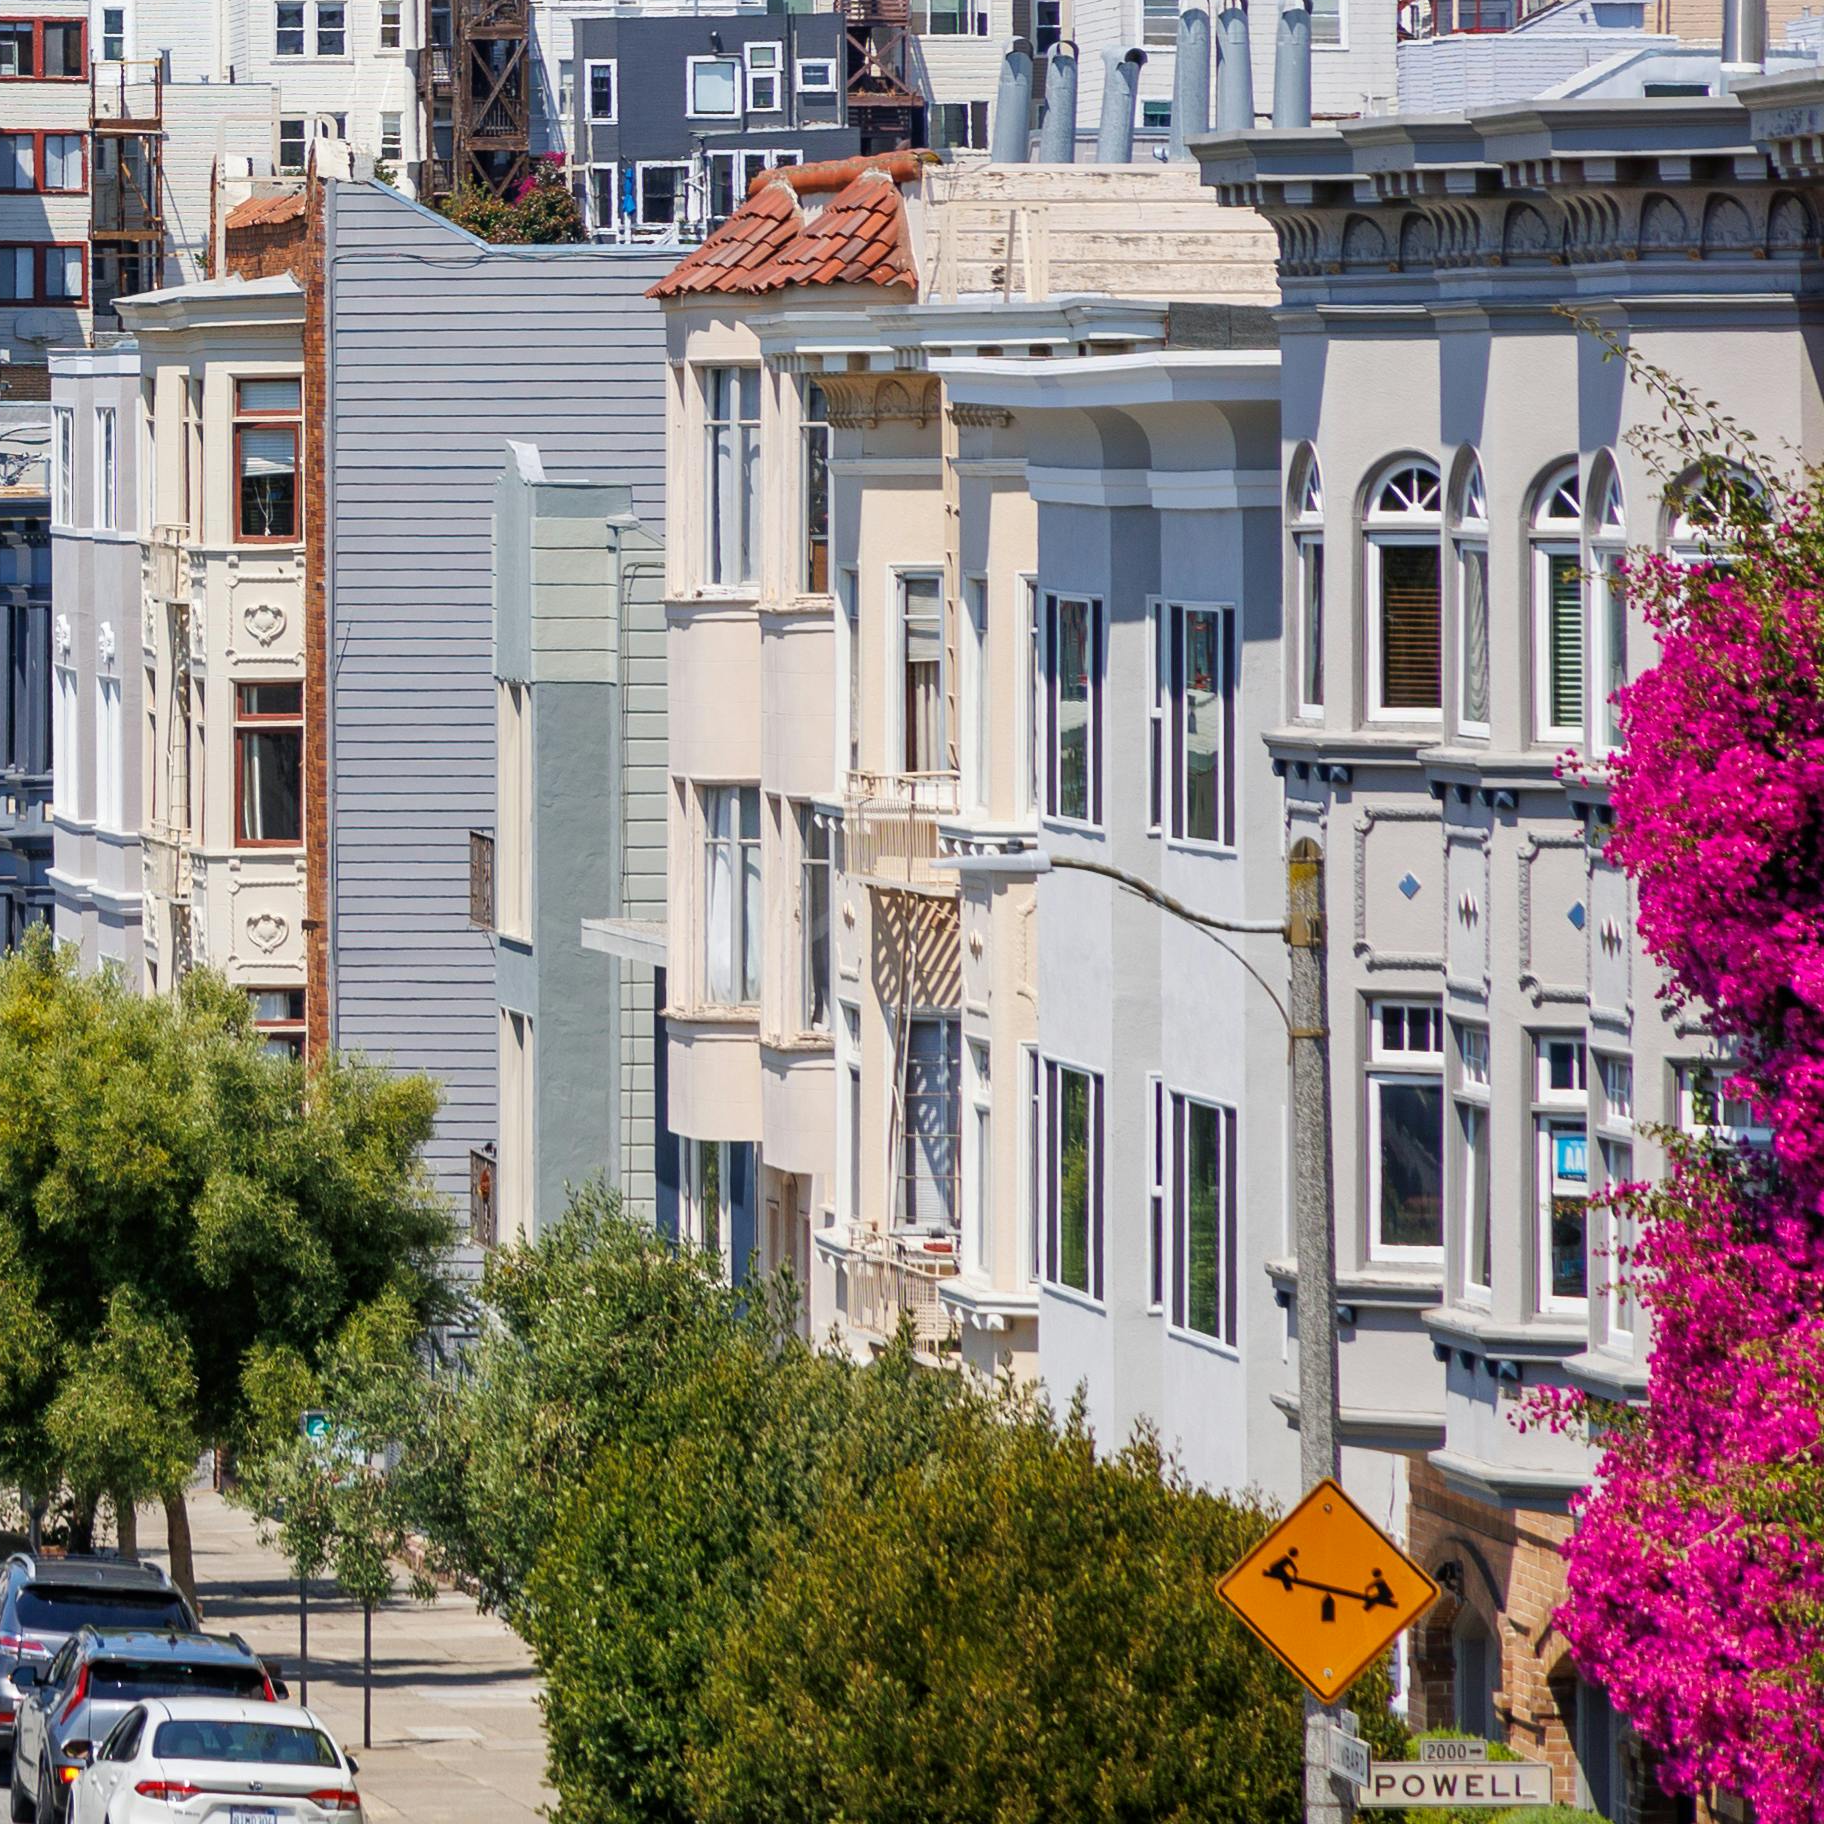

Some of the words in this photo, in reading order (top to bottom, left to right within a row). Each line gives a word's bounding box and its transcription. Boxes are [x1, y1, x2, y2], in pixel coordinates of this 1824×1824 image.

[1564, 1146, 1588, 1171] AA
[312, 1419, 325, 1435] 2
[1427, 1743, 1468, 1760] 2000
[1375, 1773, 1539, 1798] POWELL
